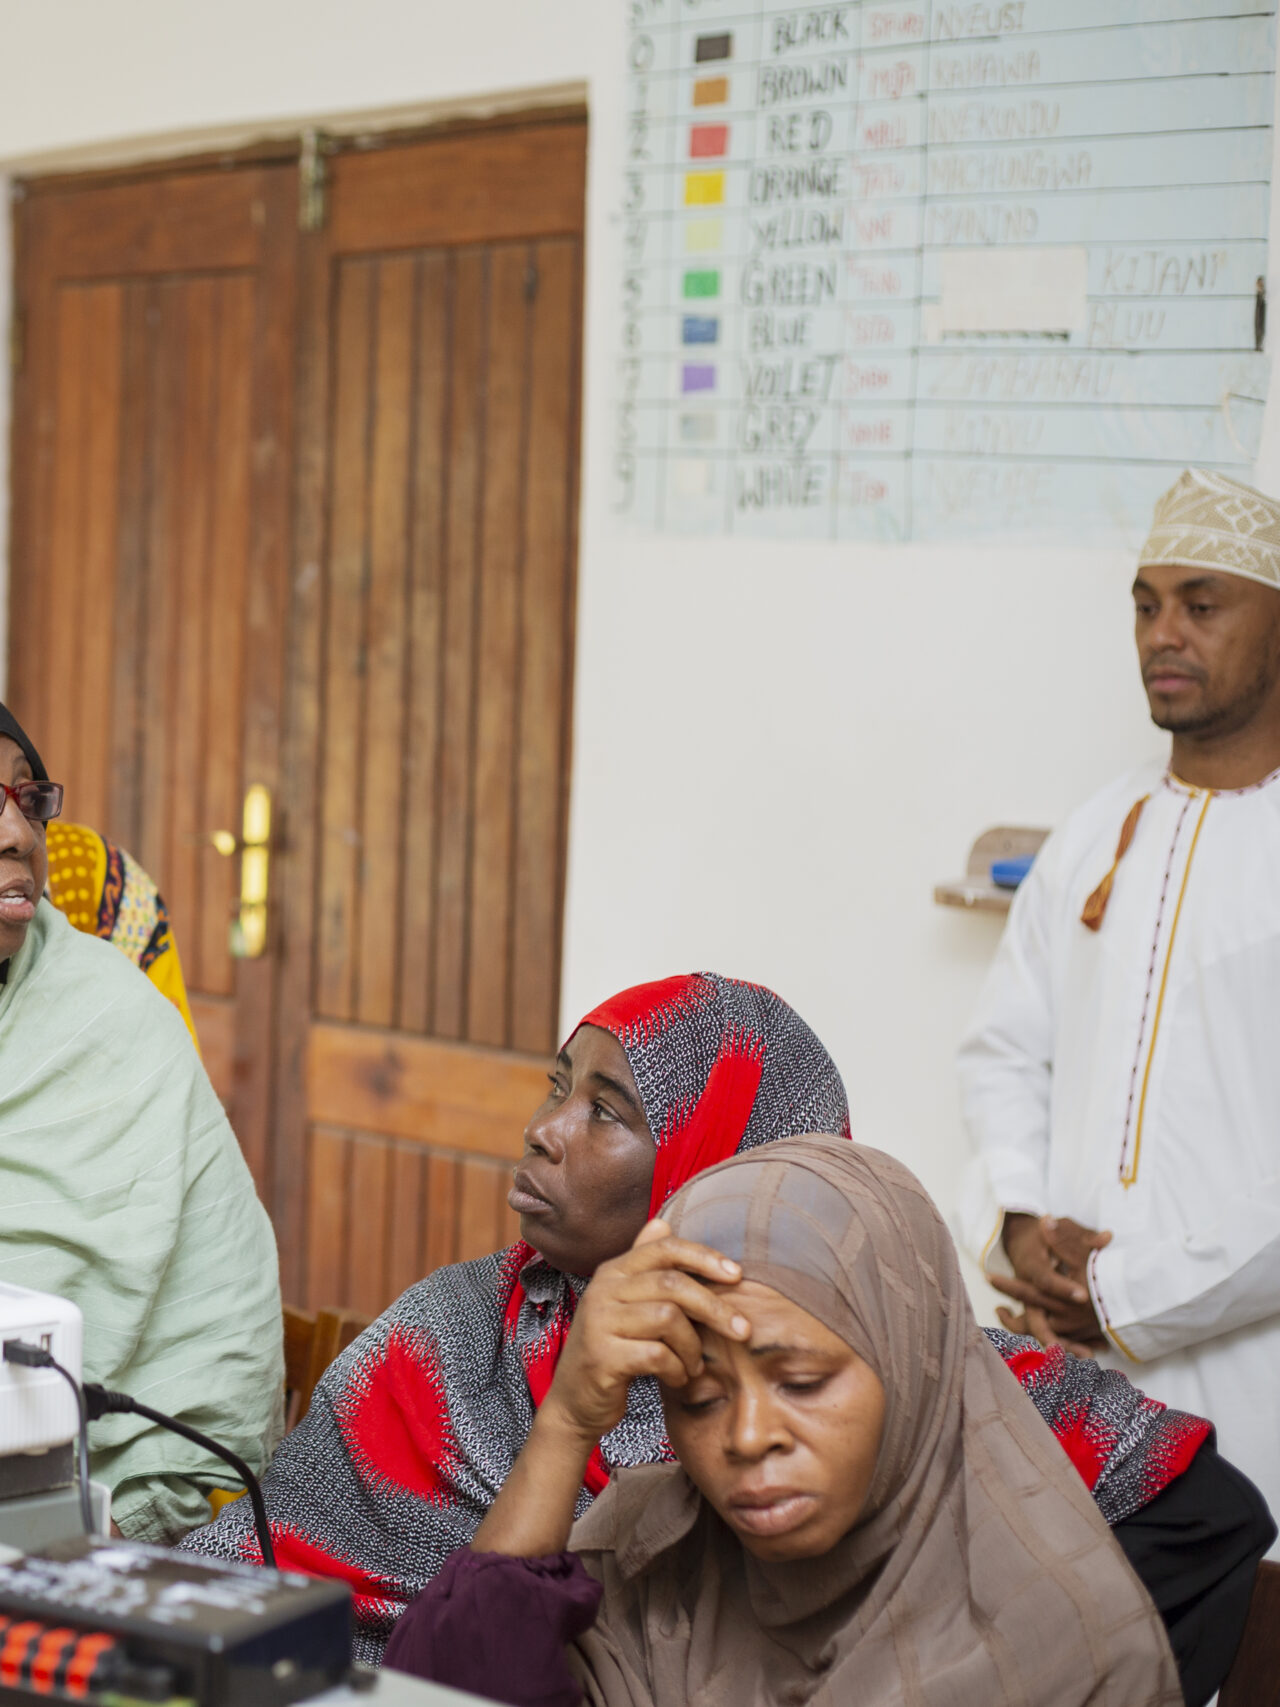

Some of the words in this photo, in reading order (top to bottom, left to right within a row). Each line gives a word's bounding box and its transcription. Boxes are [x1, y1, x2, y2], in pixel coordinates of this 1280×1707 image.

[772, 8, 849, 55] BLACK
[760, 56, 848, 106] BROWN
[766, 109, 833, 154] RED
[749, 157, 847, 206] ORANGE
[740, 258, 839, 306] GREEN
[748, 309, 813, 352] BLUE
[736, 403, 820, 457] GREY
[735, 458, 827, 513] WHITE
